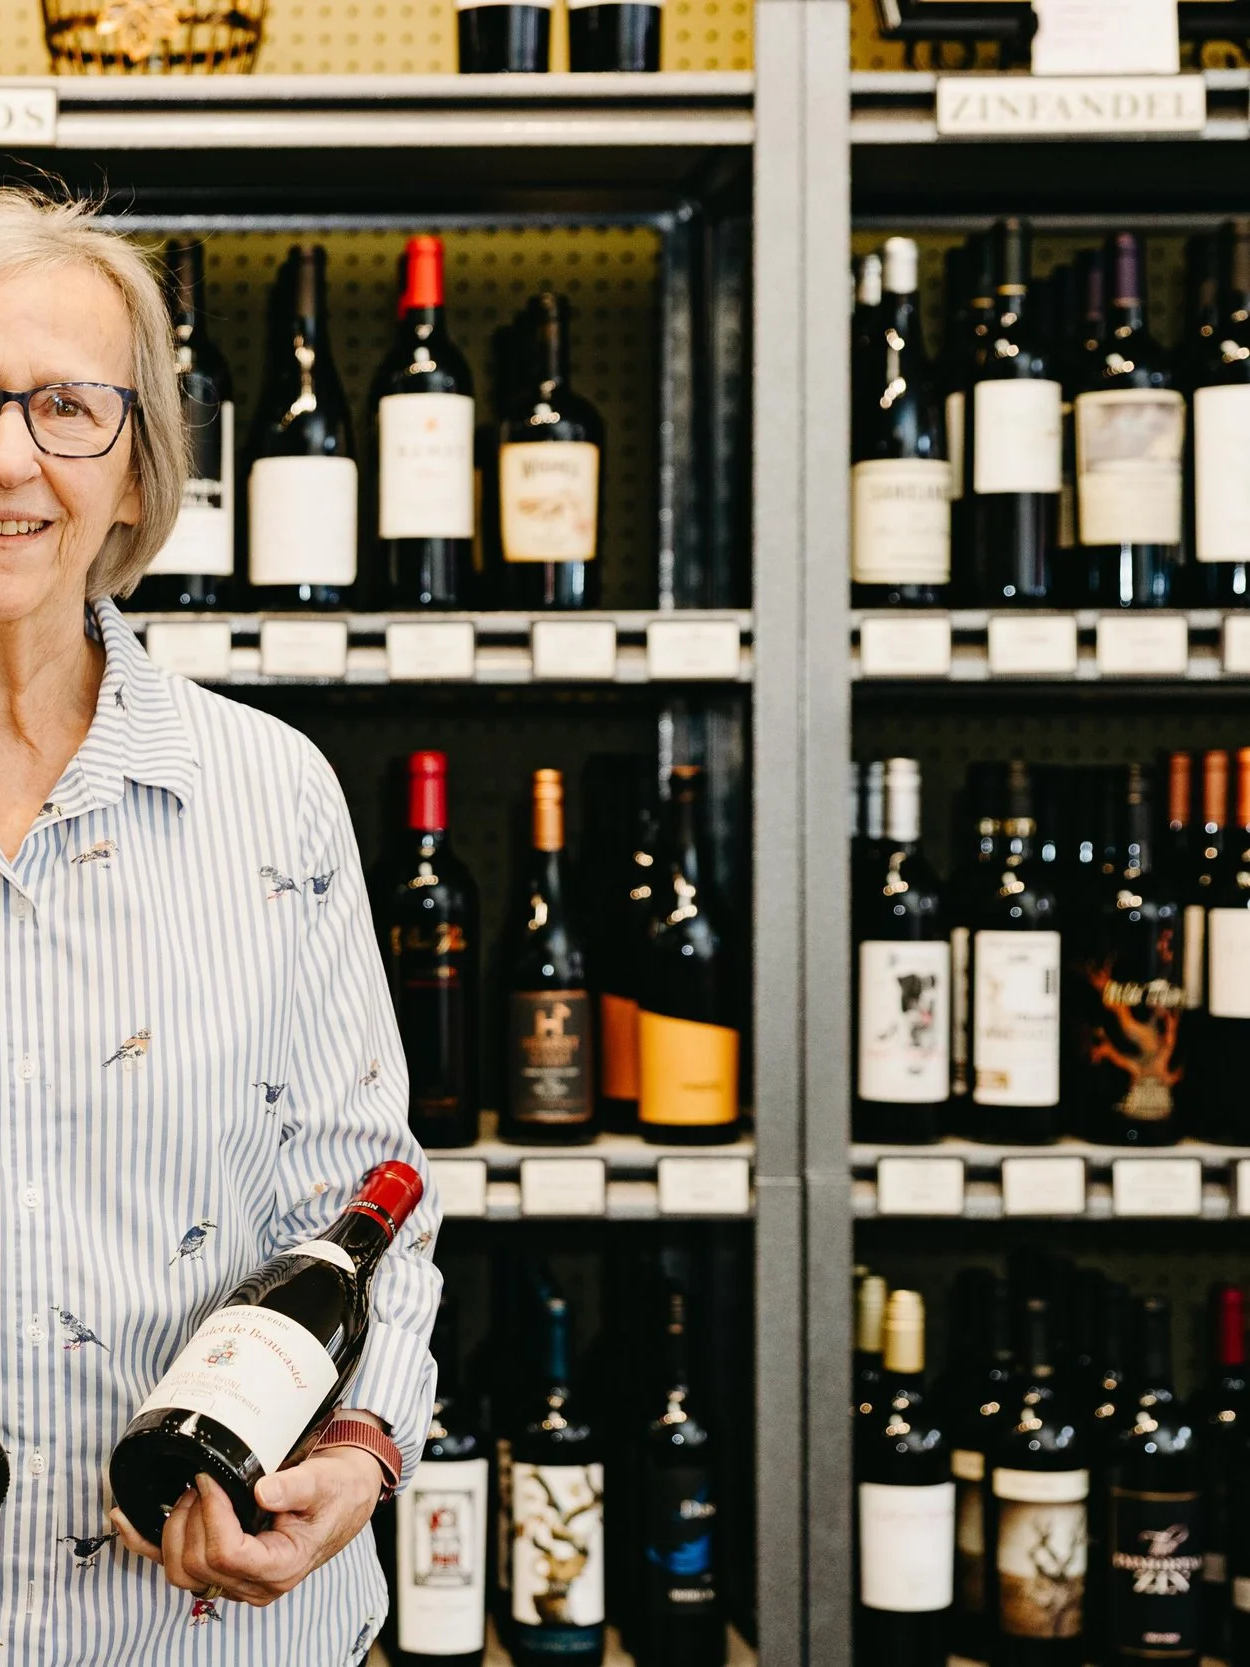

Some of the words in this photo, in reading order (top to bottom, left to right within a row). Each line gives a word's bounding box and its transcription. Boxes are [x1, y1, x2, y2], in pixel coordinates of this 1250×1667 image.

[951, 91, 1198, 122] ZINFANDEL
[255, 1312, 290, 1331] PERRIN
[229, 1323, 247, 1335] de
[249, 1327, 308, 1390] Beaucastel
